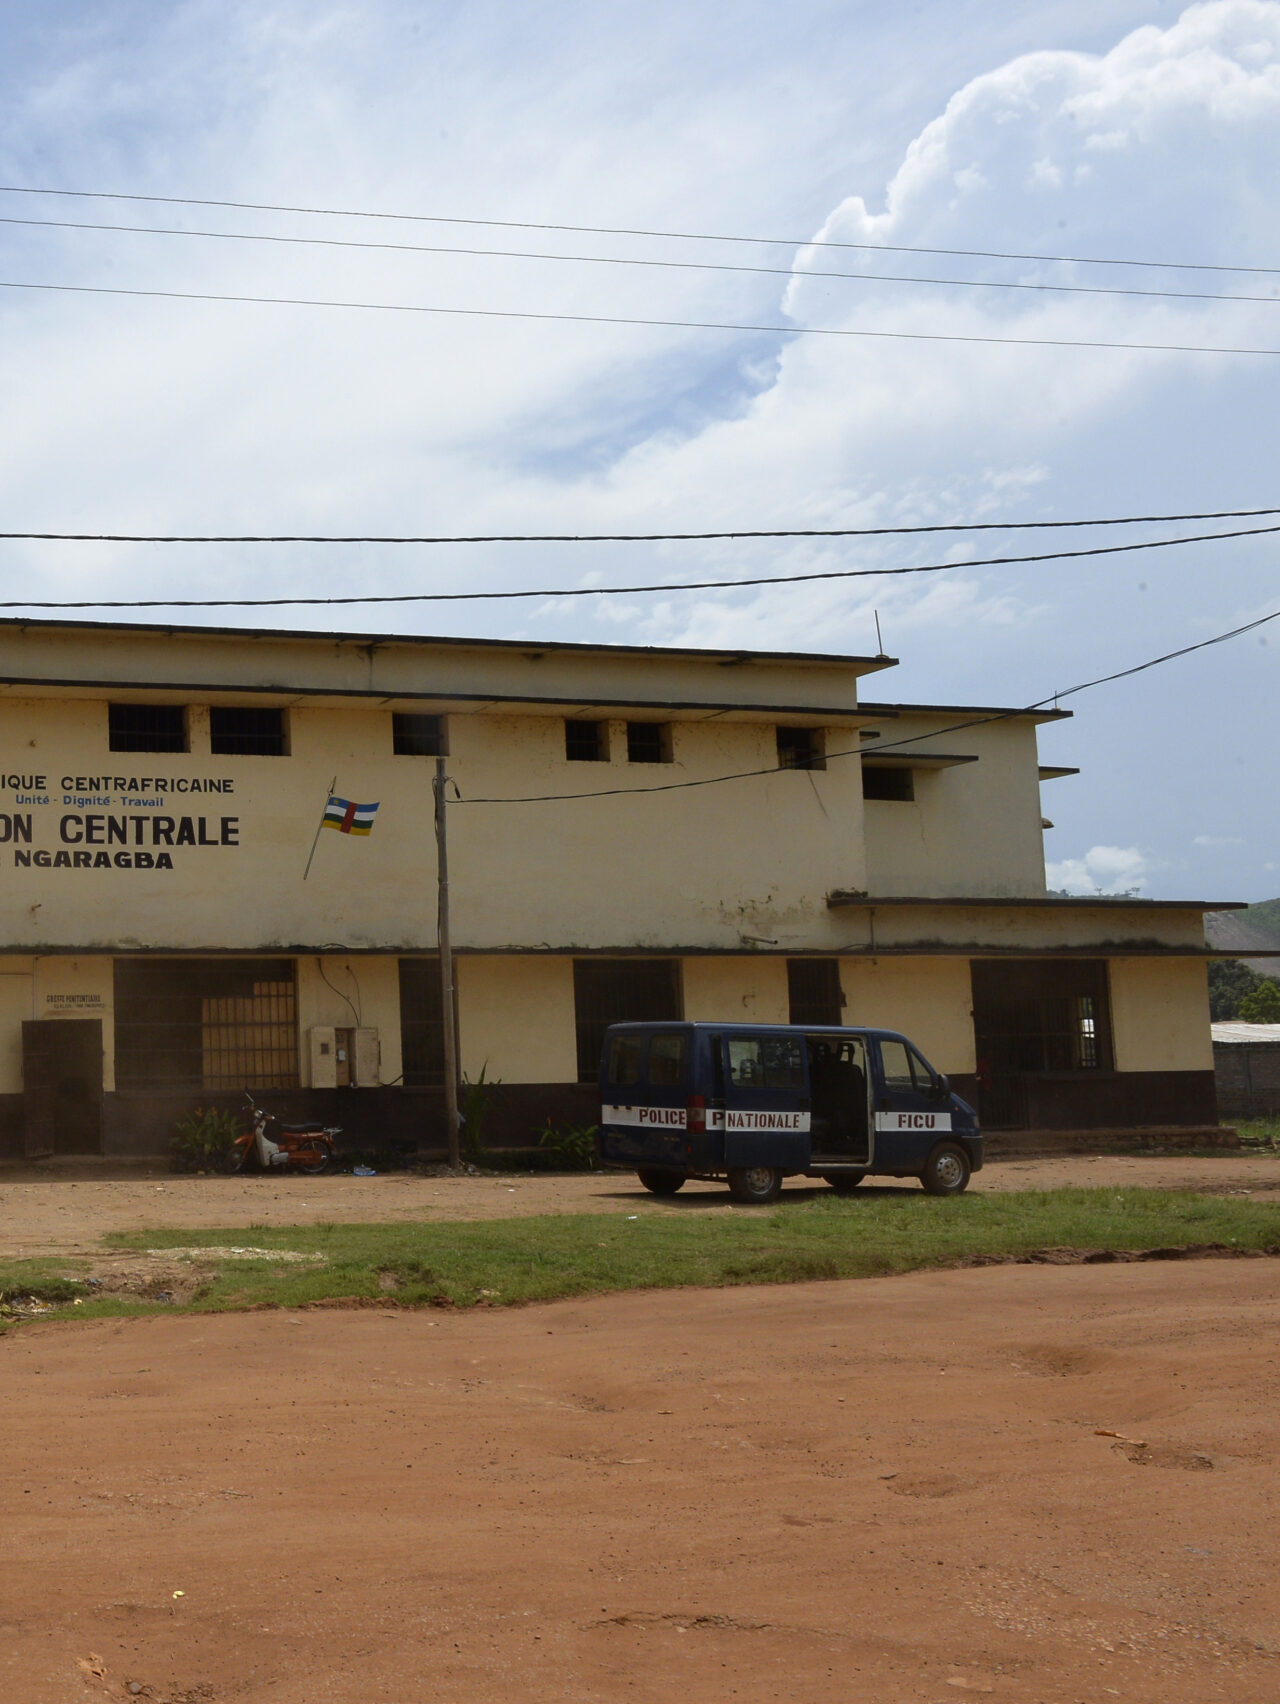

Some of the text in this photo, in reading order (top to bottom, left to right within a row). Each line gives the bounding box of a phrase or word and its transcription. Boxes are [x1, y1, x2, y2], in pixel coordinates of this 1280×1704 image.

[61, 776, 234, 793] CENTRAFRICAINE
[16, 794, 50, 805] Unité
[63, 794, 111, 808] Dignité
[120, 796, 164, 807] Travail
[60, 814, 240, 846] CENTRALE
[14, 850, 174, 869] NGARAGBA
[639, 1107, 686, 1126] POLICE
[727, 1112, 800, 1129] NATIONALE
[897, 1113, 936, 1129] FICU
